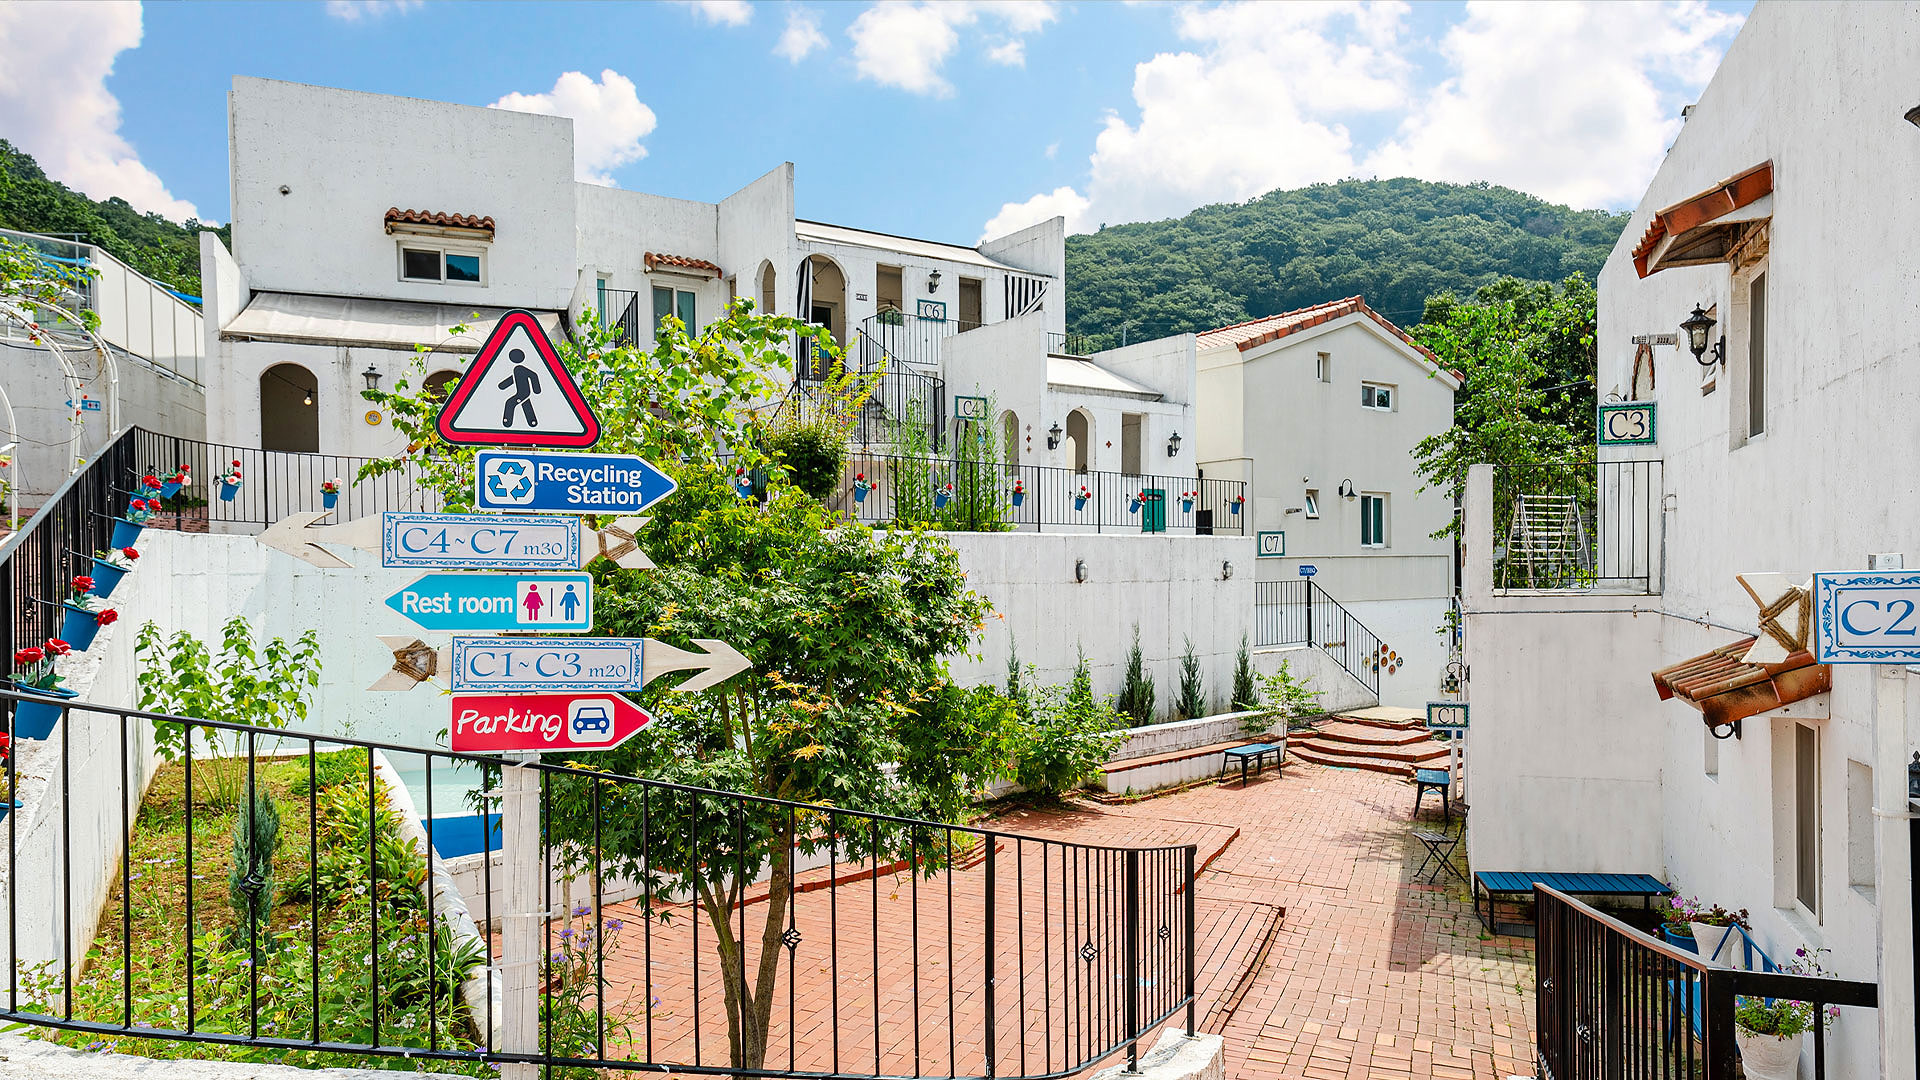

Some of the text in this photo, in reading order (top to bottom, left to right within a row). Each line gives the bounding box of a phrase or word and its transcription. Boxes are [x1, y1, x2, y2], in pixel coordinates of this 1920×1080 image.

[924, 303, 939, 318] C6
[963, 400, 980, 415] C4
[1608, 411, 1645, 439] C3
[538, 462, 642, 488] Recycling
[567, 486, 642, 505] Station
[523, 543, 562, 556] m30
[1264, 535, 1279, 553] C7
[402, 591, 513, 613] Rest room
[1841, 600, 1917, 636] C2
[589, 664, 627, 678] m20
[457, 708, 563, 742] Parking
[1438, 708, 1457, 724] C1
